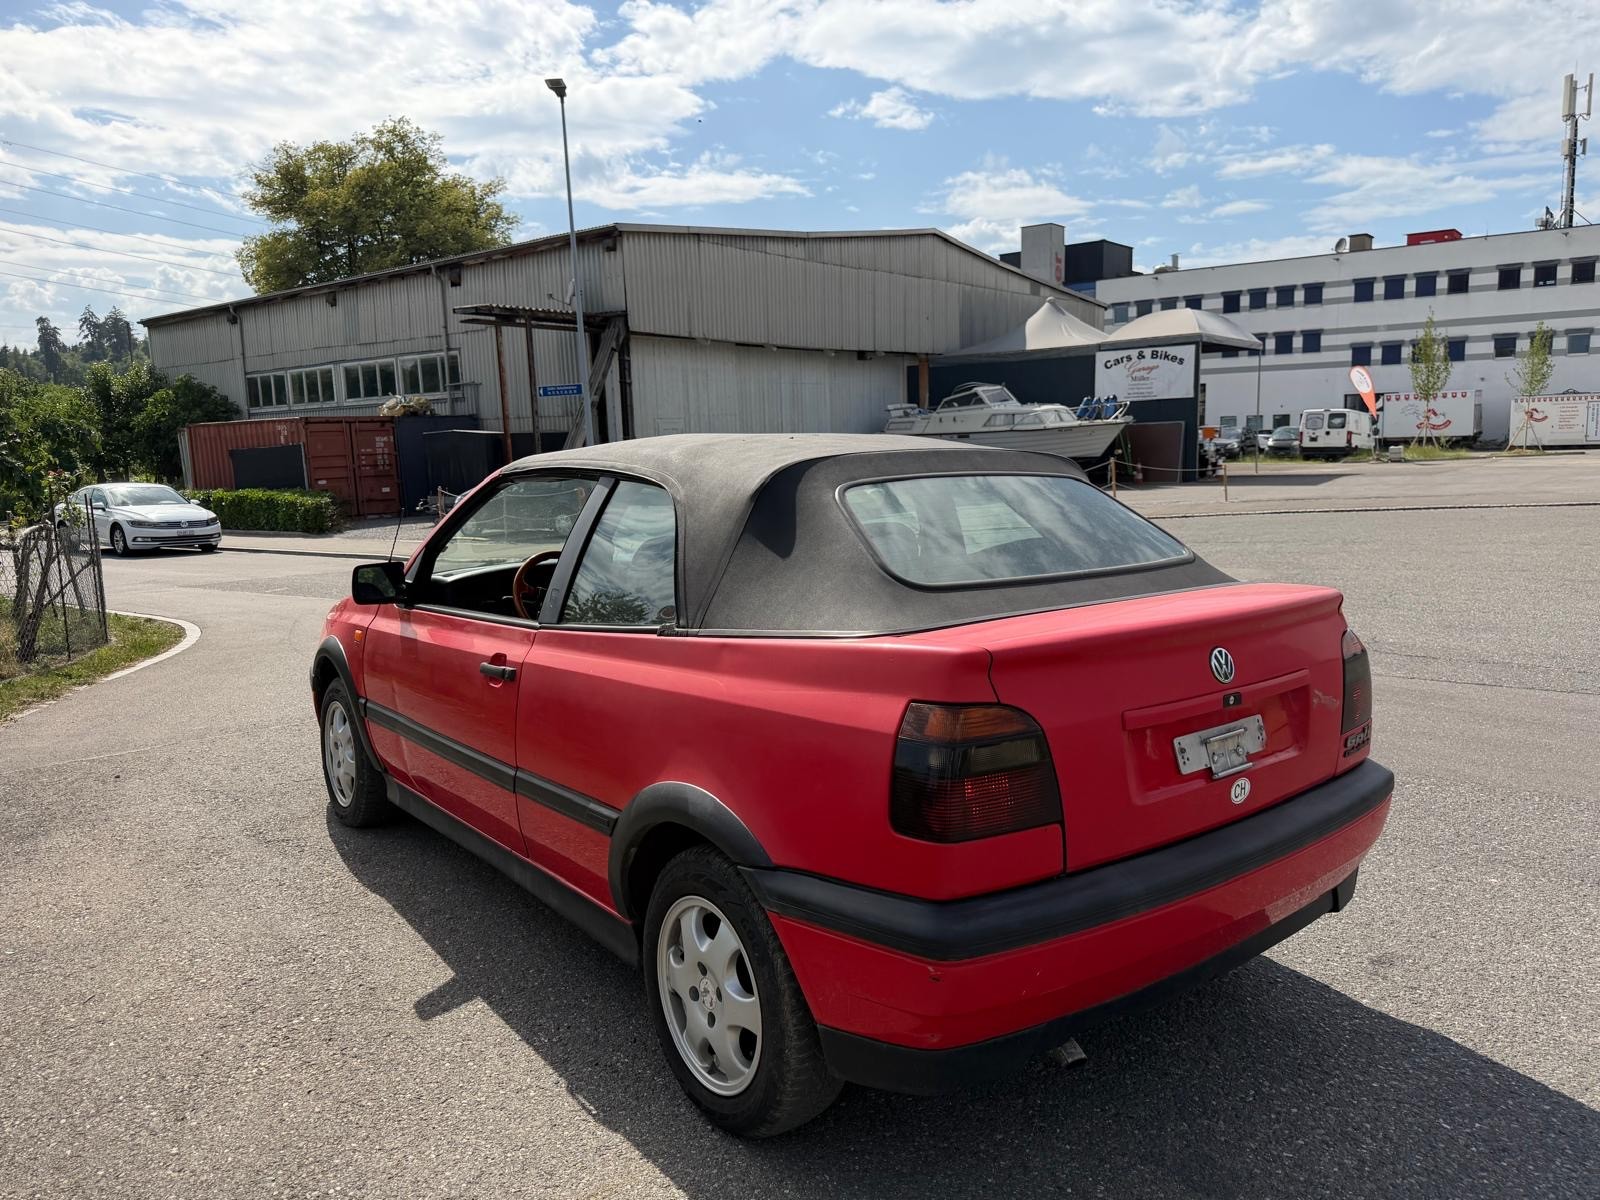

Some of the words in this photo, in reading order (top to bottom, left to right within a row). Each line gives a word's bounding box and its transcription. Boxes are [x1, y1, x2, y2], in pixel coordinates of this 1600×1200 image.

[1104, 354, 1133, 369] Cars
[1137, 350, 1146, 360] &
[1151, 350, 1185, 365] Bikes
[1234, 783, 1247, 799] CH
